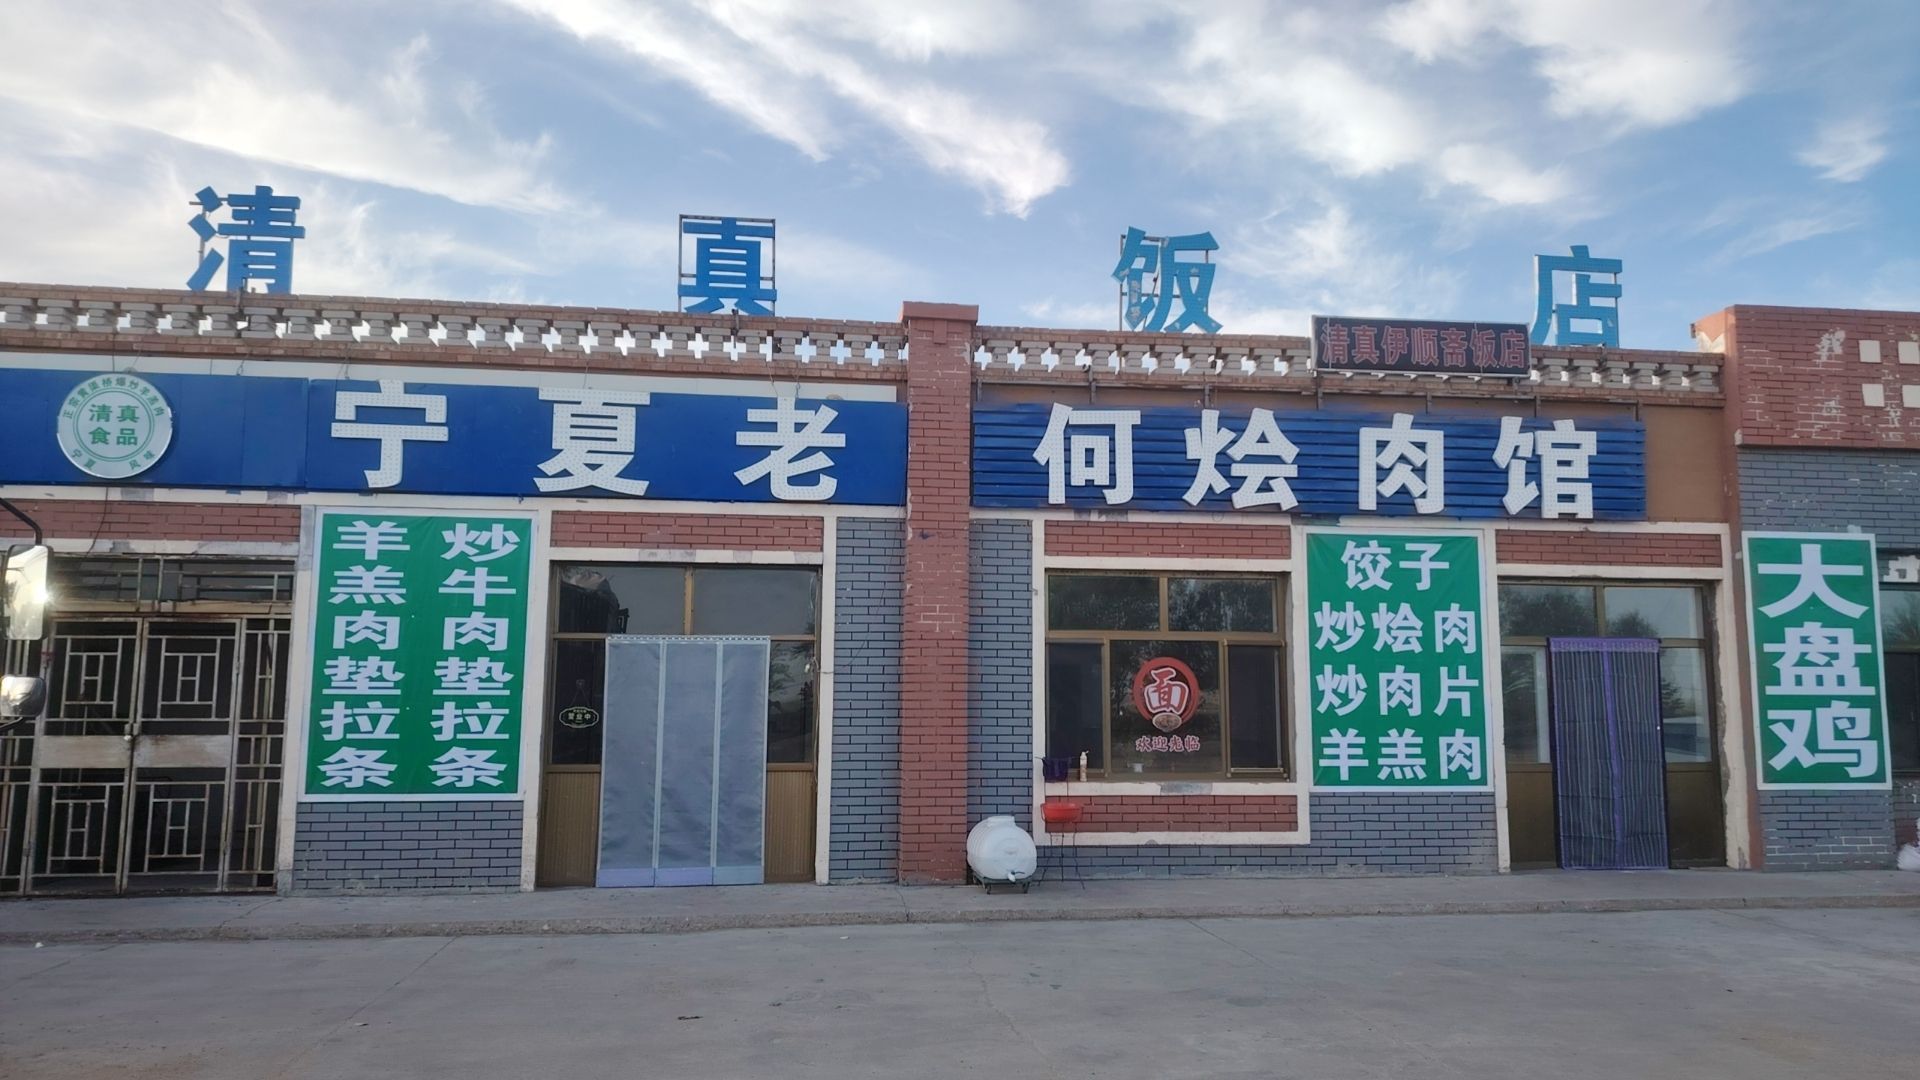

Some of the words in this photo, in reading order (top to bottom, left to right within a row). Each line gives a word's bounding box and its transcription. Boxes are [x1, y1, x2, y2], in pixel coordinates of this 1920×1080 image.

[186, 185, 1622, 347] 清真饭店
[1321, 323, 1525, 369] 清真伊顺斋饭店
[88, 403, 140, 423] 清真
[89, 426, 138, 446] 食品
[1341, 540, 1449, 591] 饺子
[317, 520, 410, 788] 羊羔肉垫拉条
[1314, 601, 1477, 654] 炒烩肉
[428, 523, 521, 788] 炒牛肉垫拉条
[1757, 543, 1878, 778] 大盘鸡
[1144, 667, 1189, 715] 面
[1315, 664, 1479, 717] 炒肉片
[1135, 735, 1201, 753] 欢迎光临
[1319, 728, 1482, 781] 羊羔肉
